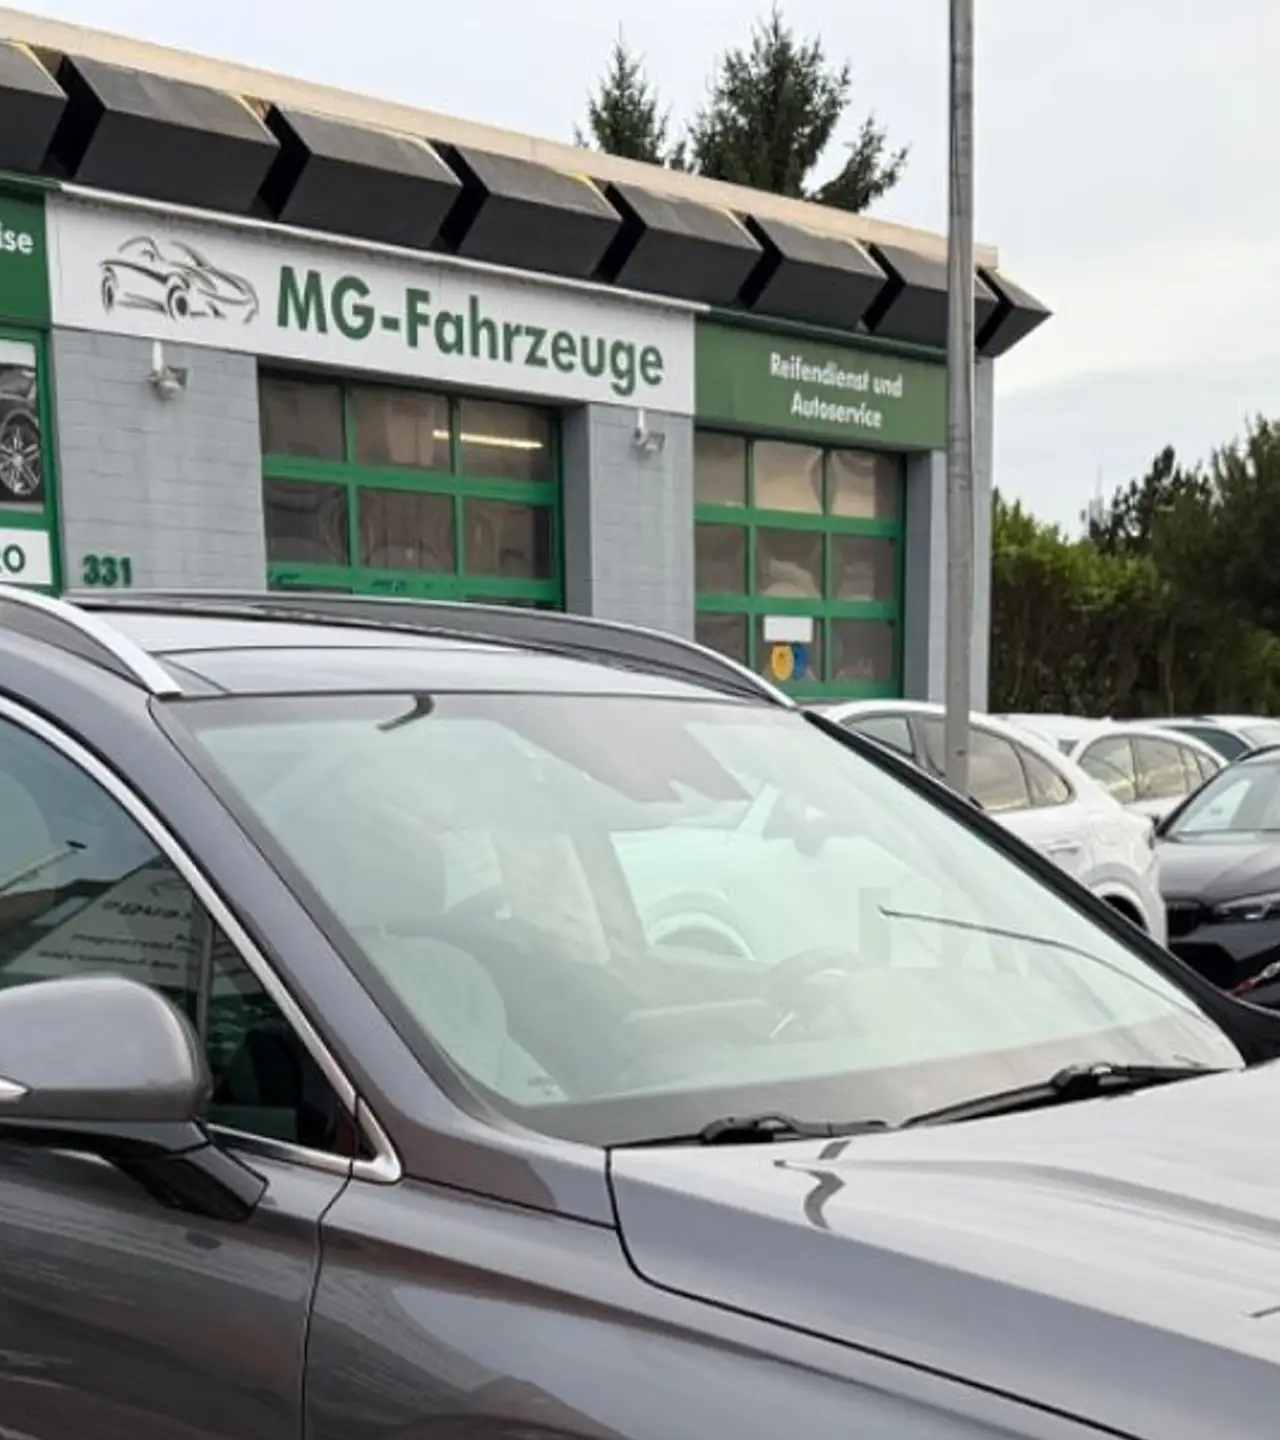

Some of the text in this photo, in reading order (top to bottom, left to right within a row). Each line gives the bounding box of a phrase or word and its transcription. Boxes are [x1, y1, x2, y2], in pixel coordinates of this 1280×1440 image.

[276, 265, 664, 397] MG-Fahrzeuge
[770, 351, 904, 398] Reifendienst und
[790, 389, 883, 429] Autoservice
[82, 554, 133, 587] 331
